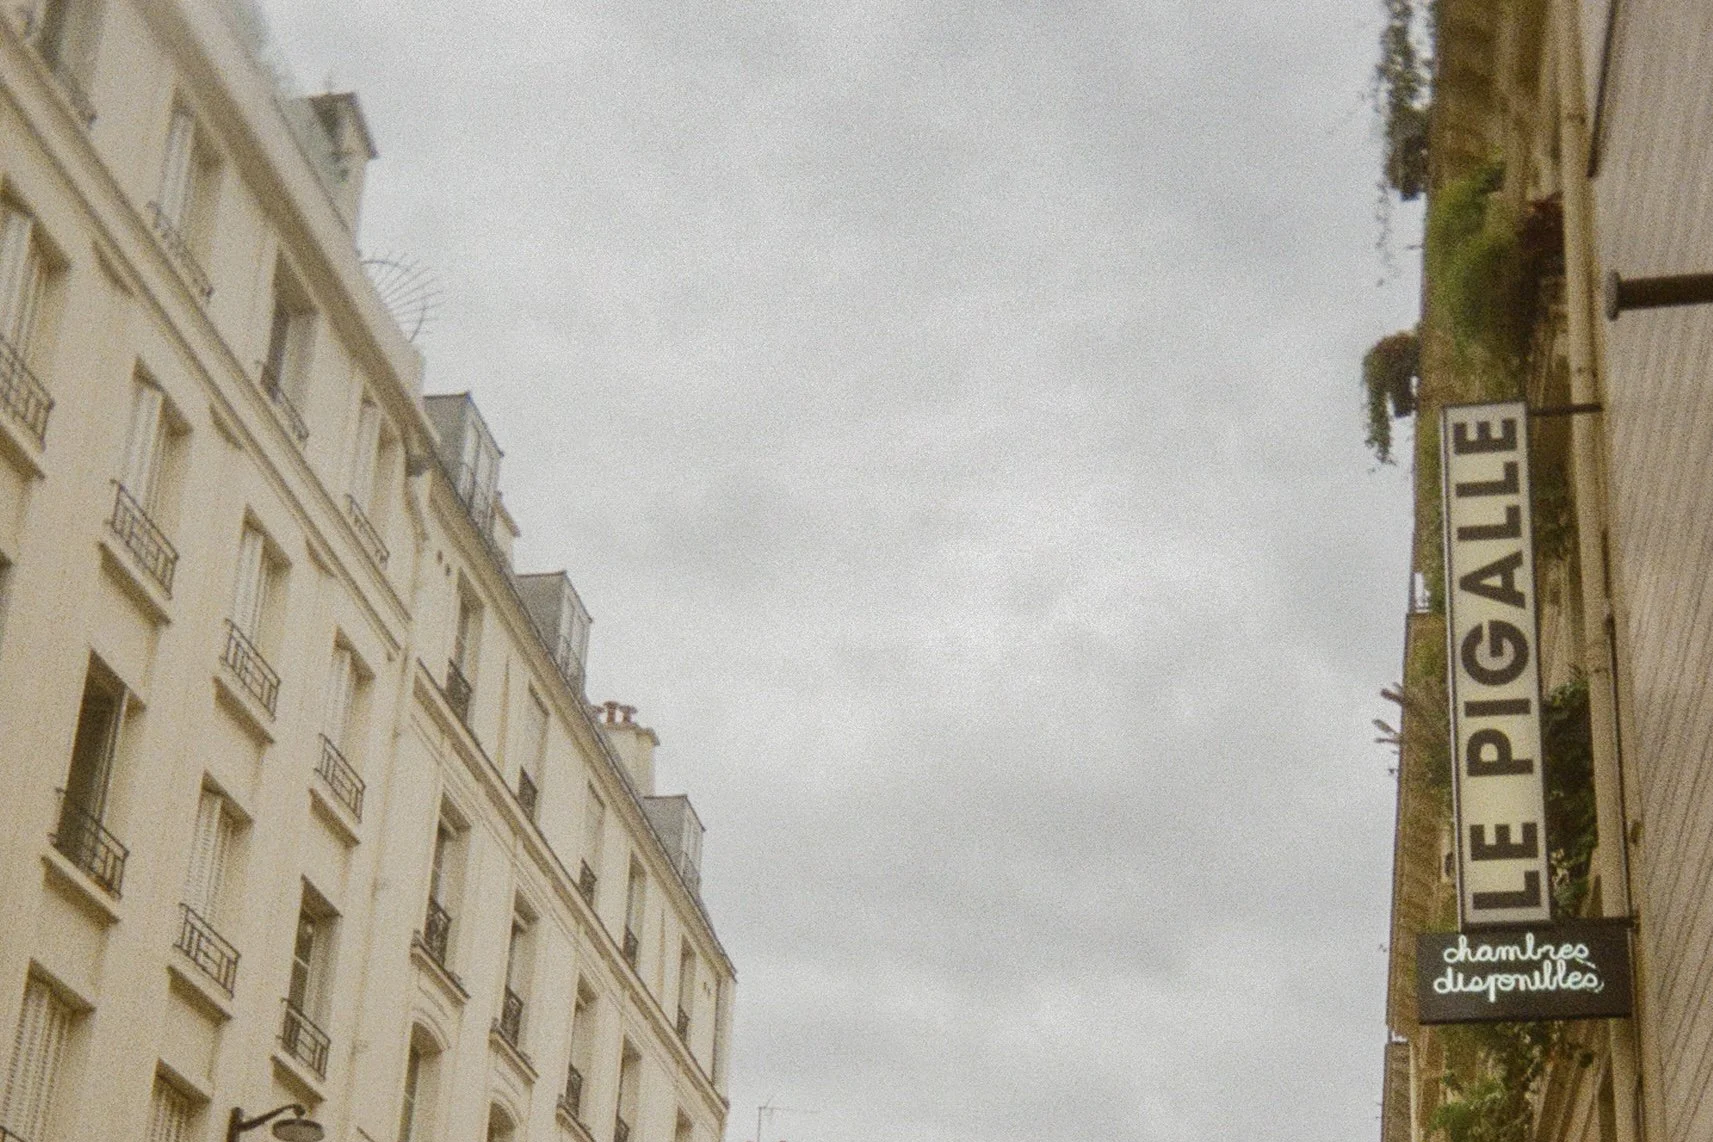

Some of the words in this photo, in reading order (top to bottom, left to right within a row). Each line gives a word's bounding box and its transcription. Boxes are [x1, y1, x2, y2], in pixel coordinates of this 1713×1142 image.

[1453, 417, 1534, 777] PIGALLE
[1469, 821, 1542, 910] LE
[1432, 959, 1605, 1003] disponibles
[1442, 932, 1597, 969] chambres
